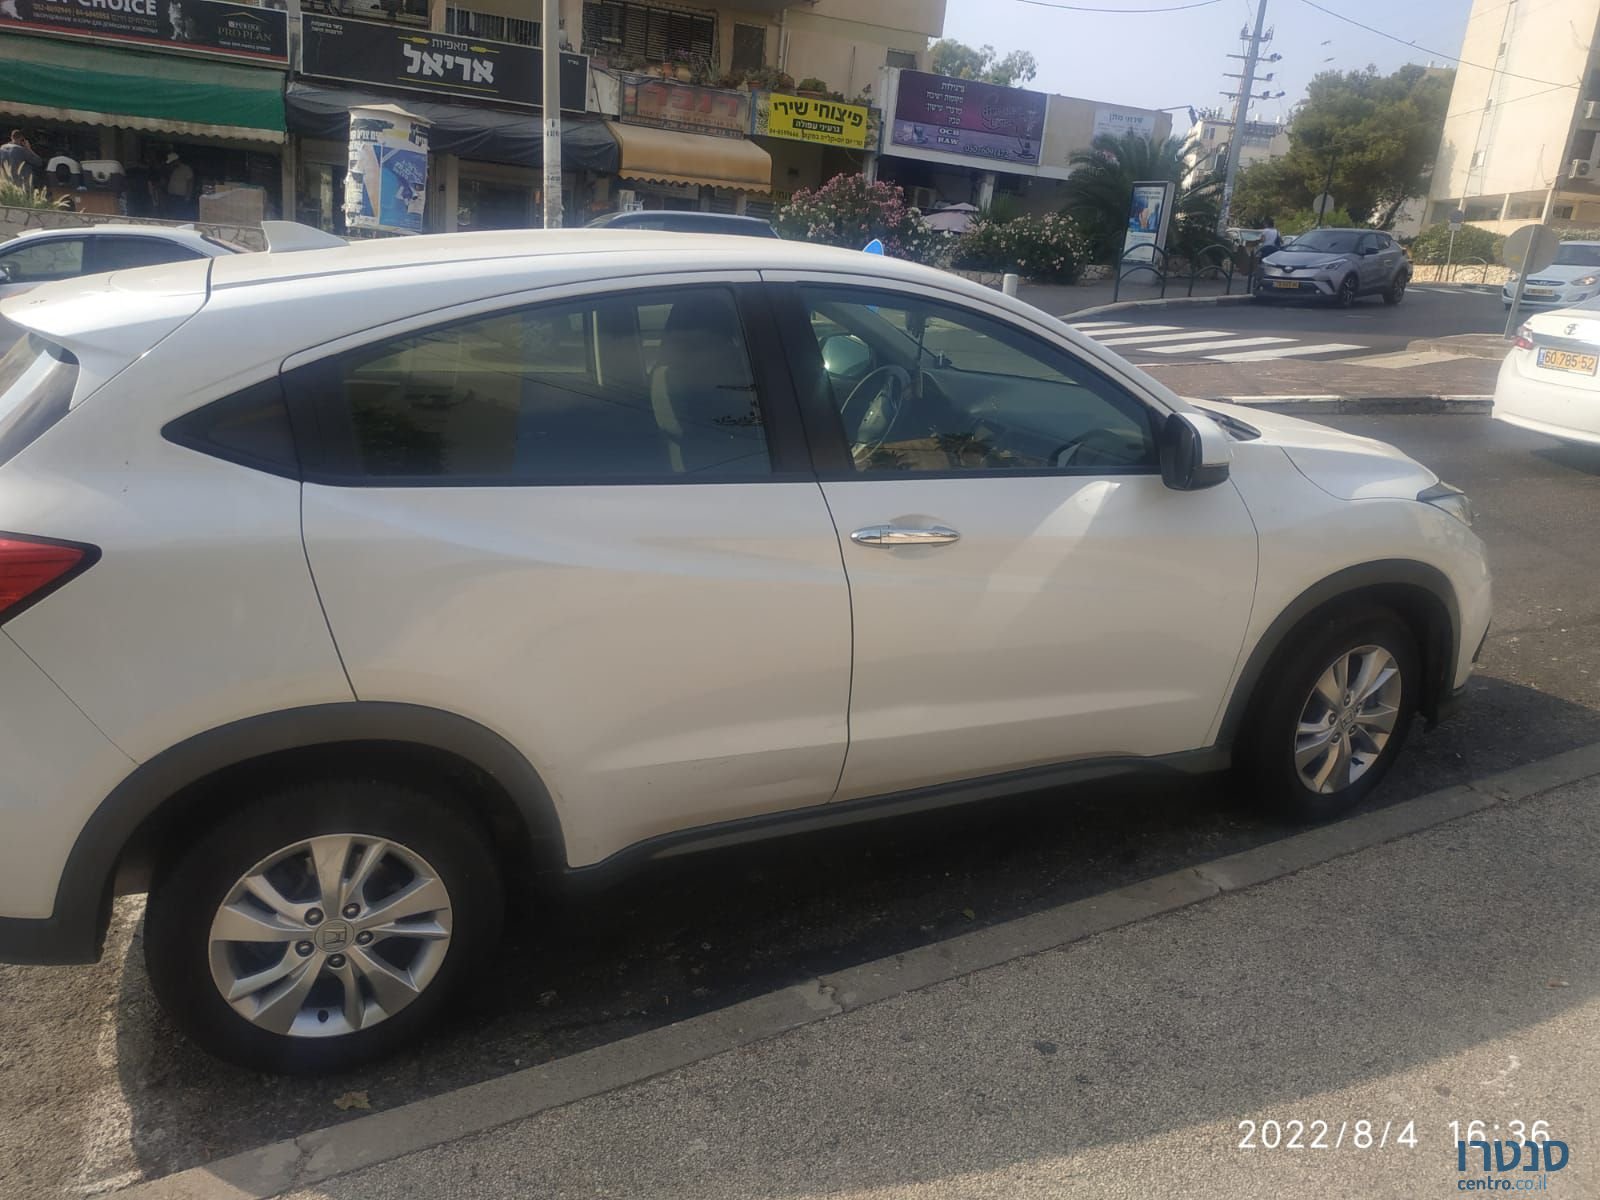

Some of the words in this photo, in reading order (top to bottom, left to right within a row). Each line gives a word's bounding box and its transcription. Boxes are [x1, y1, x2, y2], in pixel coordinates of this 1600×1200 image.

[431, 38, 468, 52] מאפיות
[403, 43, 494, 84] אריאל
[773, 101, 809, 116] שירי
[814, 103, 863, 127] פיצוחי
[937, 137, 960, 145] RAW
